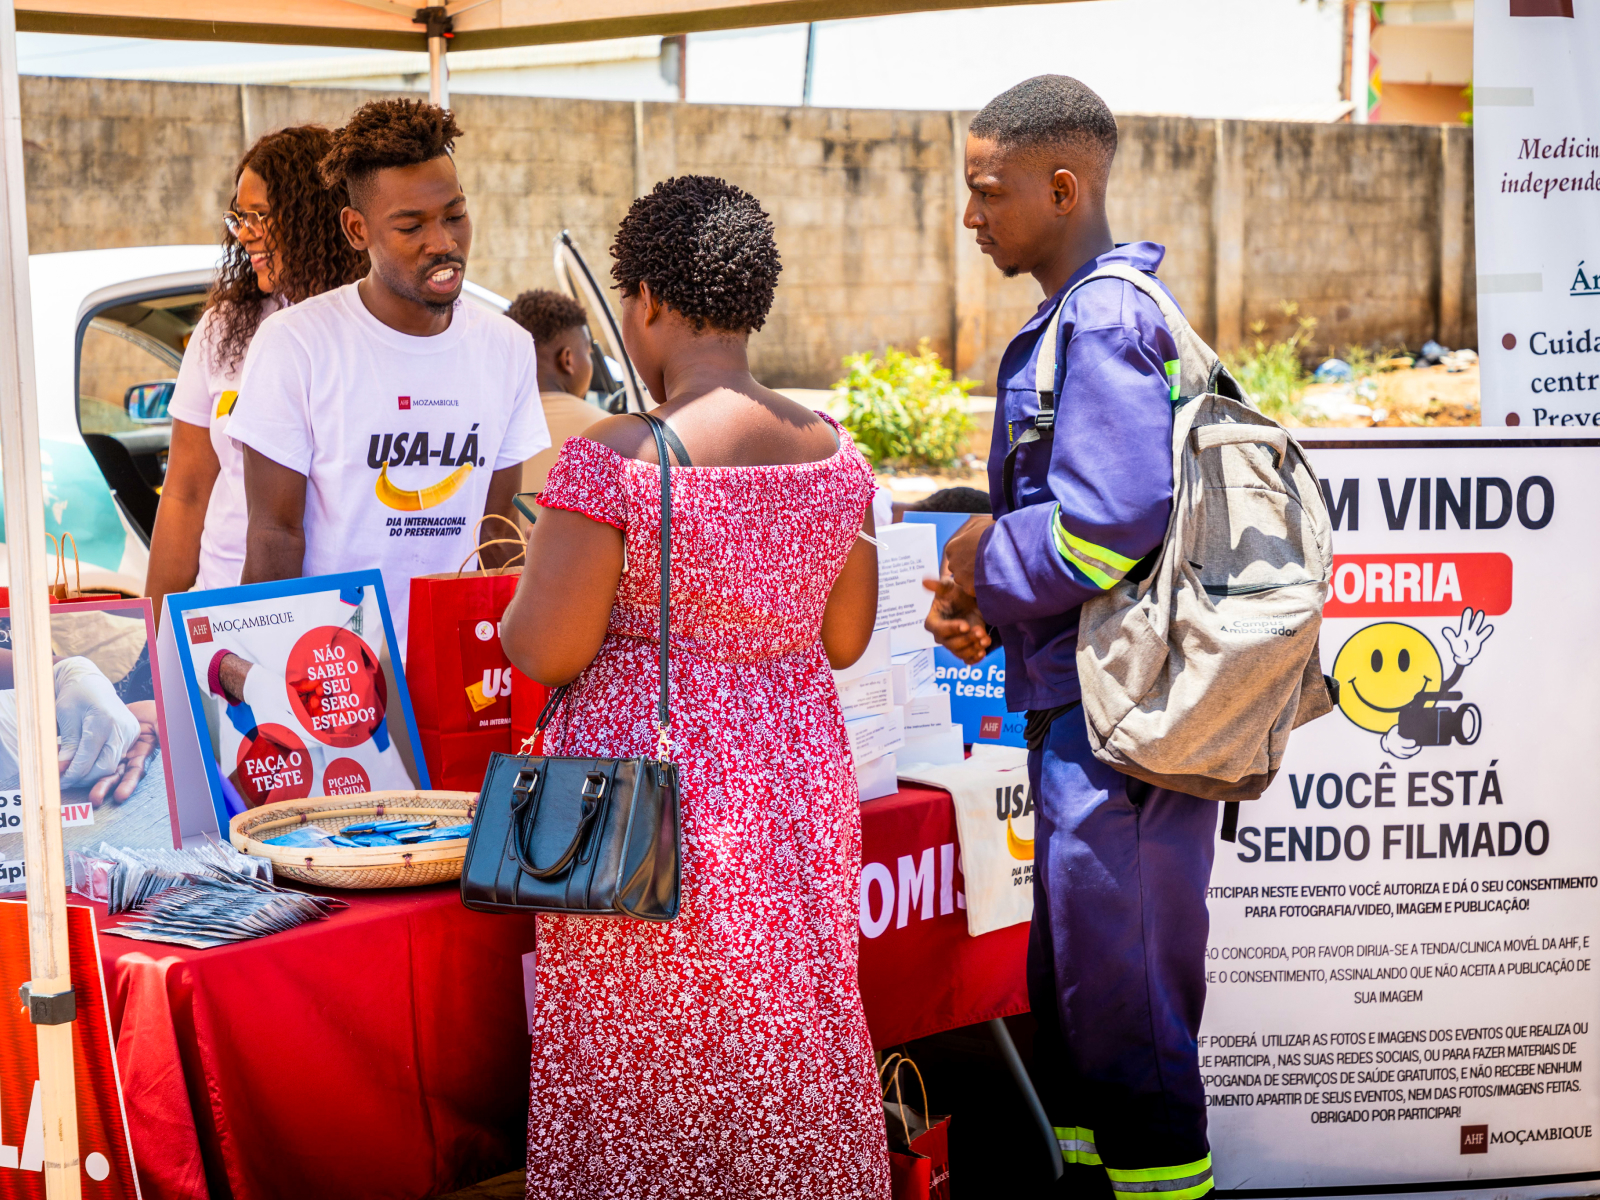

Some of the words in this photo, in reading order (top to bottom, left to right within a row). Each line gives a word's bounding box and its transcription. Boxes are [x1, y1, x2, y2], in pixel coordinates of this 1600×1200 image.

[1518, 136, 1600, 160] Medicin
[1531, 371, 1599, 394] centr
[412, 399, 459, 407] MOZAMBIQUE
[367, 423, 486, 469] USA-LÁ.
[1377, 475, 1555, 531] VINDO
[386, 517, 402, 527] DIA
[404, 516, 466, 526] INTERNACIONAL
[389, 528, 402, 537] DO
[404, 526, 461, 537] PRESERVATIVO
[193, 624, 208, 636] AHF
[212, 611, 295, 633] MOÇAMBIQUE
[1220, 625, 1298, 637] Ambassador
[1233, 620, 1284, 628] Campus
[307, 662, 346, 681] SABE
[347, 660, 359, 675] O
[322, 678, 351, 696] SEU
[482, 667, 512, 698] US
[956, 680, 1005, 699] teste
[321, 693, 360, 712] SERO
[311, 707, 376, 731] ESTADO?
[982, 722, 999, 732] AHF
[245, 754, 289, 776] FAÇA
[289, 751, 302, 767] O
[252, 770, 304, 793] TESTE
[328, 773, 364, 789] PICADA
[1288, 761, 1397, 809] VOCÊ
[1407, 759, 1504, 808] ESTÁ
[1236, 824, 1371, 863] SENDO
[1382, 819, 1550, 861] FILMADO
[1011, 866, 1022, 877] DIA
[1013, 876, 1023, 887] DO
[1262, 886, 1298, 898] NESTE
[1301, 885, 1346, 897] EVENTO
[1349, 881, 1380, 896] VOCÊ
[1384, 883, 1440, 895] AUTORIZA
[1443, 882, 1450, 893] E
[1452, 878, 1468, 893] DÁ
[1471, 881, 1479, 893] O
[1482, 880, 1503, 892] SEU
[1506, 876, 1598, 891] CONSENTIMENTO
[1245, 906, 1276, 917] PARA
[1279, 903, 1394, 918] FOTOGRAFIA/VIDEO,
[1396, 902, 1442, 914] IMAGEM
[1445, 902, 1452, 913] E
[1454, 897, 1530, 914] PUBLICAÇÃO!
[1221, 947, 1289, 961] CONCORDA,
[1292, 946, 1316, 958] POR
[1319, 945, 1354, 957] FAVOR
[1357, 944, 1408, 957] DIRIJA-SE
[1410, 944, 1418, 955] A
[1420, 941, 1501, 954] TENDA/CLINICA
[1504, 936, 1539, 951] MOVÉL
[1542, 938, 1556, 950] DA
[1558, 936, 1581, 950] AHF,
[1583, 936, 1590, 948] E
[1219, 971, 1227, 983] O
[1230, 969, 1327, 983] CONSENTIMENTO,
[1329, 967, 1407, 981] ASSINALANDO
[1410, 966, 1432, 979] QUE
[1435, 963, 1458, 977] NÃO
[1460, 964, 1496, 976] ACEITA
[1498, 964, 1505, 975] A
[1508, 958, 1574, 975] PUBLICAÇÃO
[1577, 959, 1591, 971] DE
[1354, 991, 1377, 1004] SUA
[1379, 990, 1423, 1003] IMAGEM
[1211, 1032, 1257, 1048] PODERÁ
[1262, 1034, 1310, 1047] UTILIZAR
[1313, 1033, 1328, 1046] AS
[1330, 1032, 1366, 1045] FOTOS
[1369, 1032, 1376, 1044] E
[1378, 1030, 1426, 1043] IMAGENS
[1429, 1029, 1453, 1042] DOS
[1455, 1027, 1503, 1041] EVENTOS
[1505, 1026, 1528, 1039] QUE
[1529, 1023, 1570, 1037] REALIZA
[1573, 1022, 1589, 1034] OU
[1278, 1054, 1301, 1066] NAS
[1304, 1053, 1334, 1065] SUAS
[1337, 1051, 1373, 1064] REDES
[1376, 1050, 1421, 1064] SOCIAIS,
[1424, 1049, 1440, 1061] OU
[1442, 1048, 1470, 1060] PARA
[1473, 1046, 1505, 1059] FAZER
[1507, 1043, 1560, 1057] MATERIAIS
[1563, 1042, 1577, 1054] DE
[1264, 1073, 1279, 1086] DE
[1281, 1072, 1337, 1087] SERVIÇOS
[1340, 1072, 1355, 1084] DE
[1357, 1067, 1394, 1083] SAÚDE
[1397, 1068, 1458, 1082] GRATUITOS,
[1461, 1067, 1468, 1079] E
[1470, 1064, 1492, 1078] NÃO
[1494, 1064, 1535, 1077] RECEBE
[1537, 1061, 1582, 1075] NENHUM
[1205, 1094, 1254, 1107] DIMENTO
[1256, 1093, 1302, 1105] APARTIR
[1304, 1092, 1319, 1104] DE
[1322, 1091, 1351, 1104] SEUS
[1354, 1089, 1405, 1103] EVENTOS,
[1408, 1088, 1432, 1100] NEM
[1434, 1087, 1456, 1100] DAS
[1459, 1082, 1544, 1098] FOTOS/IMAGENS
[1546, 1080, 1582, 1093] FEITAS.
[1311, 1110, 1369, 1124] OBRIGADO
[1372, 1109, 1396, 1121] POR
[1398, 1106, 1462, 1120] PARTICIPAR!
[1464, 1132, 1484, 1145] AHF
[1489, 1124, 1592, 1146] MOÇAMBIQUE
